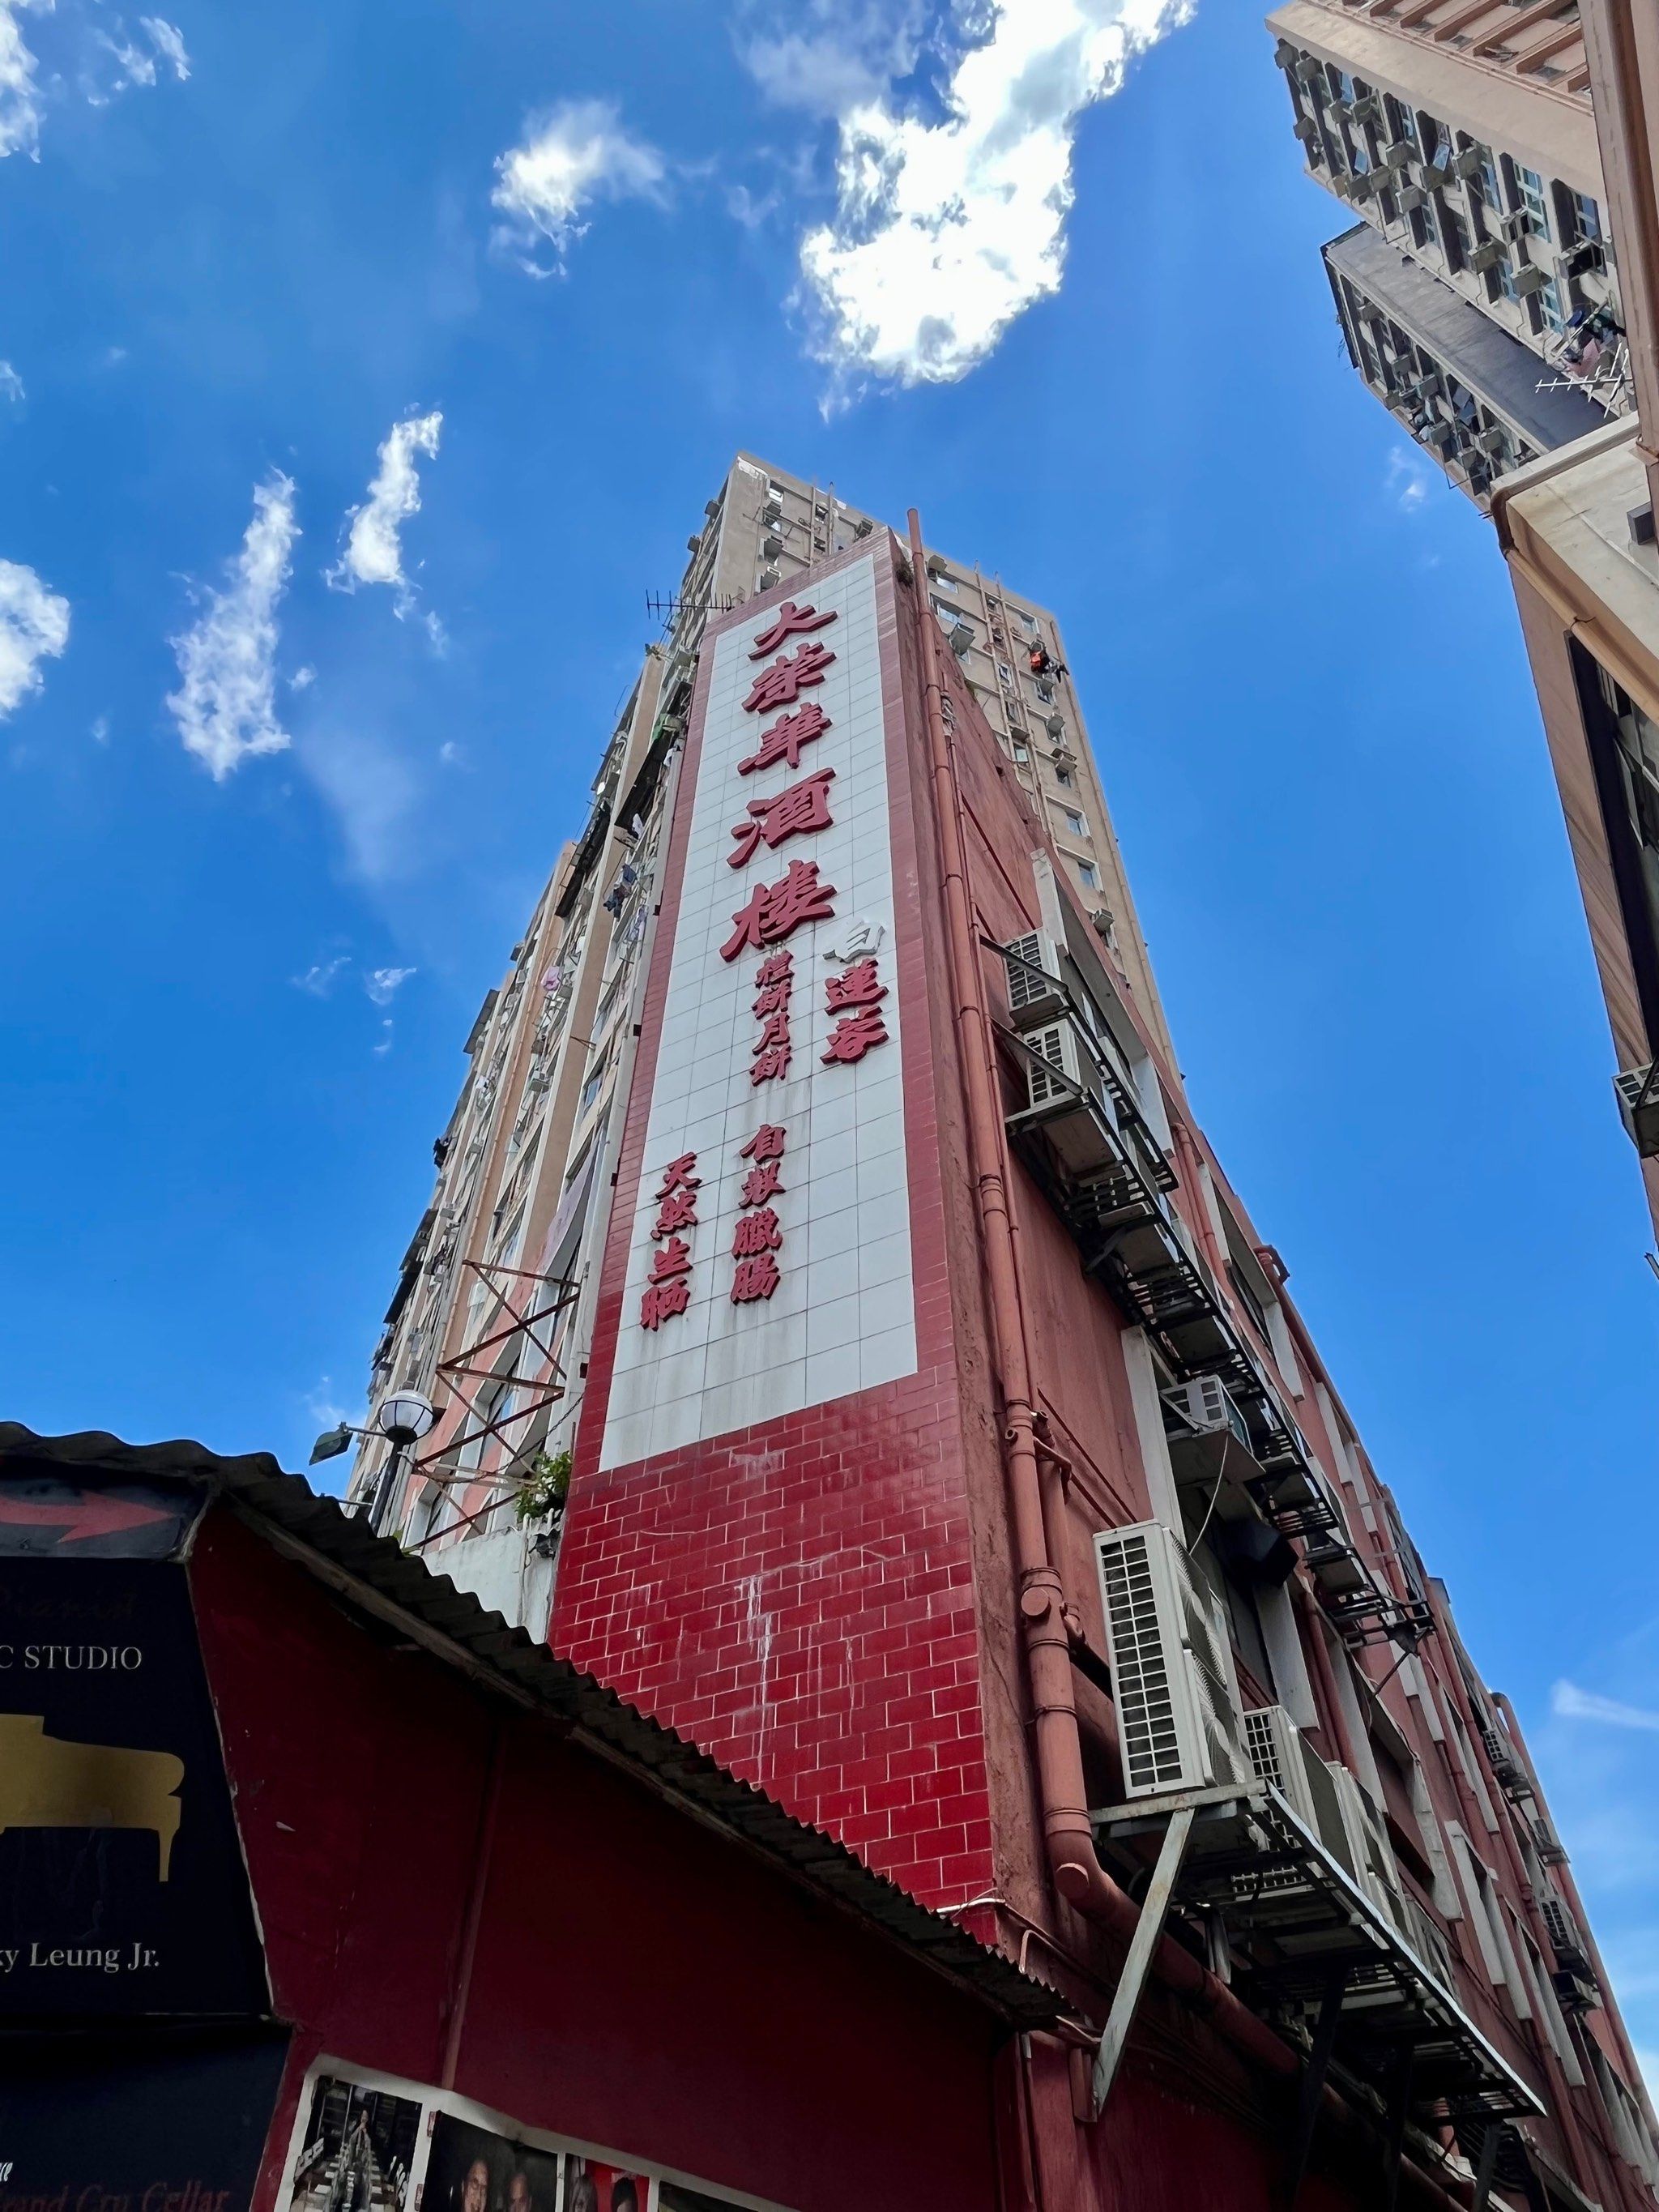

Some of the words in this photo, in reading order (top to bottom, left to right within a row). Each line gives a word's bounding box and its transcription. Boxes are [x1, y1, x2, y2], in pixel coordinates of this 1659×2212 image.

[719, 601, 838, 962] 大榮華酒樓
[819, 916, 889, 1064] 白蓮蓉
[24, 1645, 143, 1670] STUDIO
[29, 1942, 121, 1973] Leung
[127, 1942, 160, 1971] Jr.
